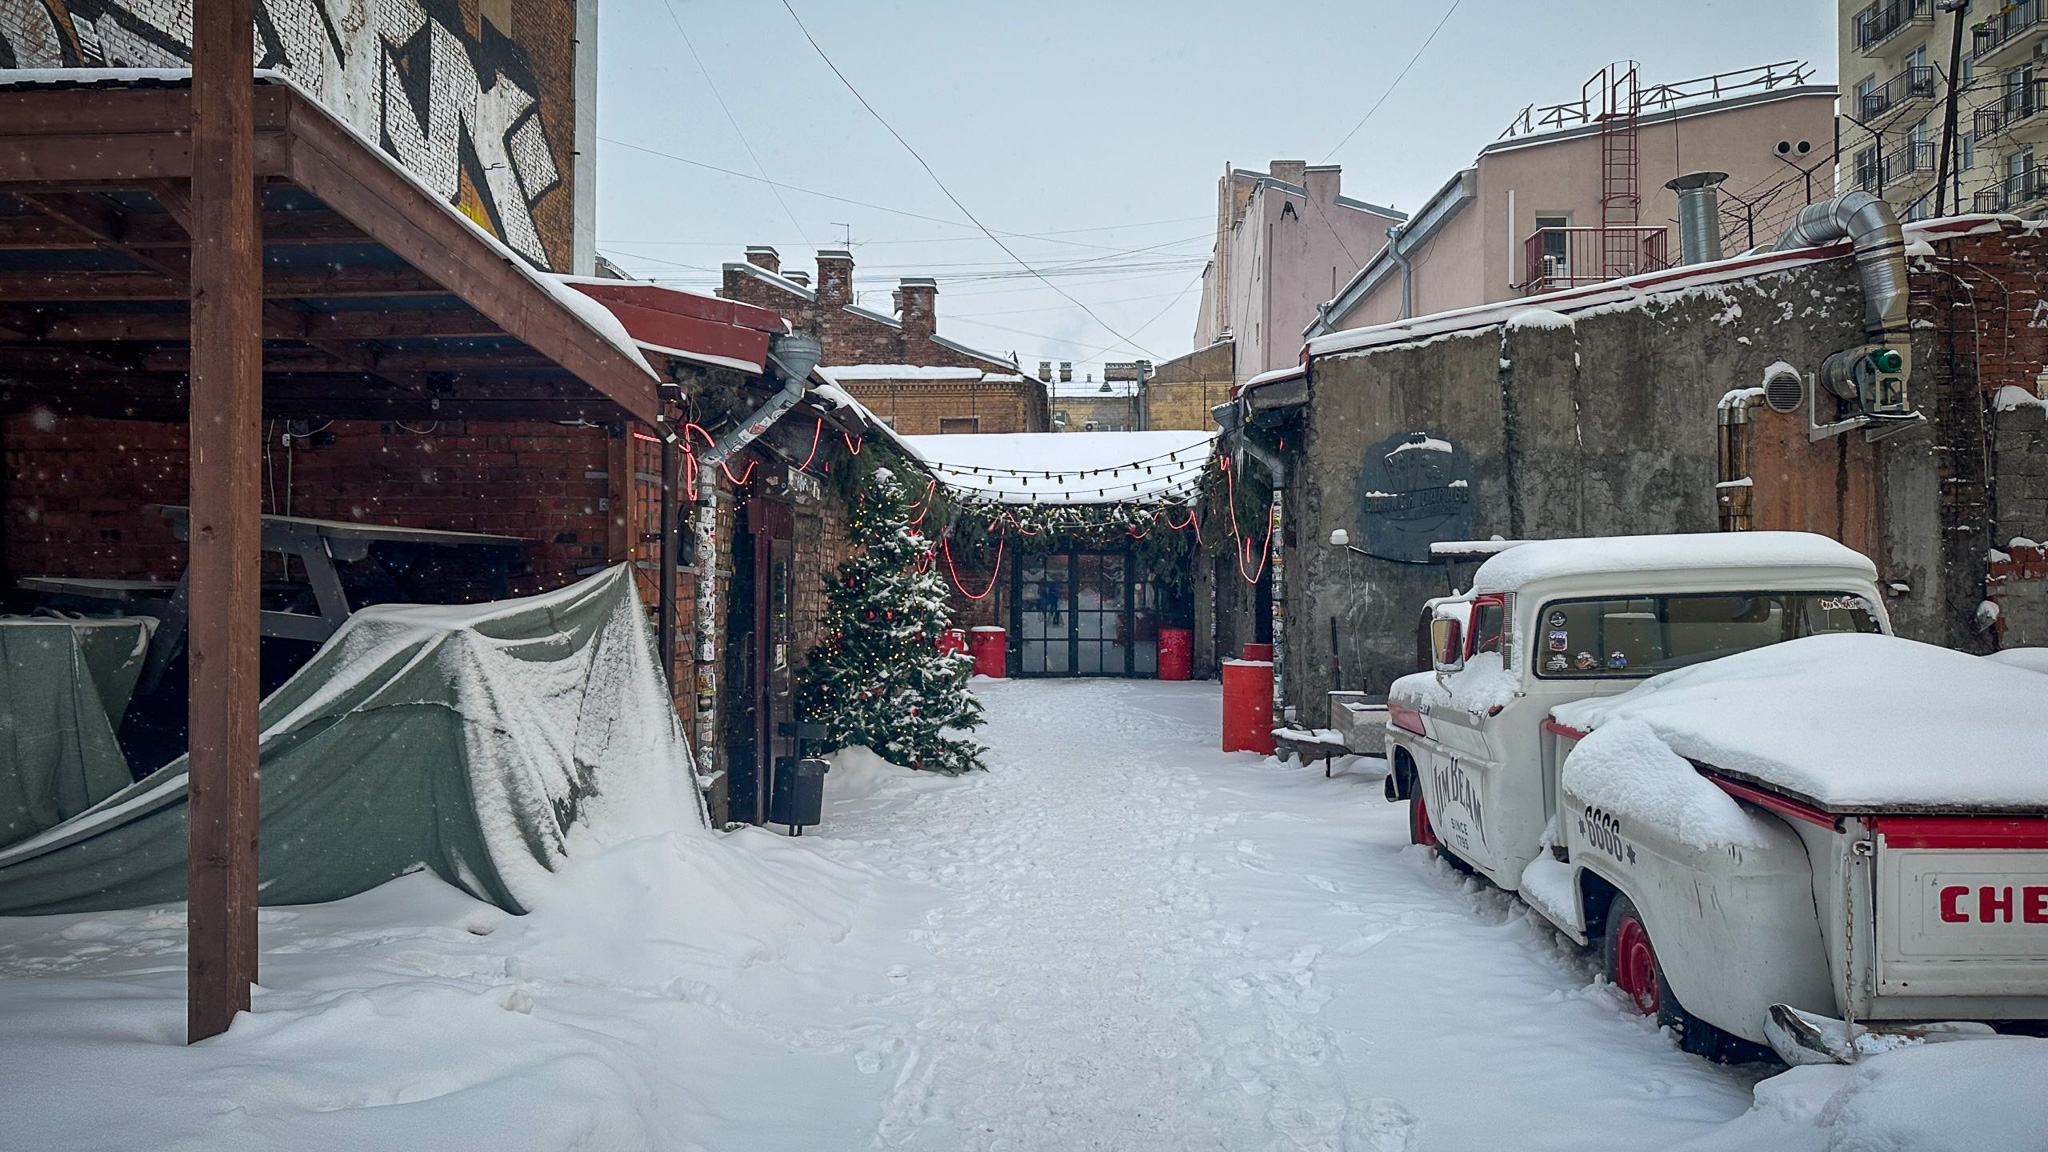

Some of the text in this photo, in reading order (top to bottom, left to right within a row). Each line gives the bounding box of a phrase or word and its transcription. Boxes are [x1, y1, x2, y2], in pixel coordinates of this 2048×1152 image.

[1420, 487, 1469, 506] GARAGE
[1433, 756, 1490, 856] JIM BEAM
[1450, 817, 1469, 836] SINCE
[1584, 805, 1623, 862] 6666
[1455, 834, 1469, 851] 1795
[1939, 885, 2048, 925] CHE
